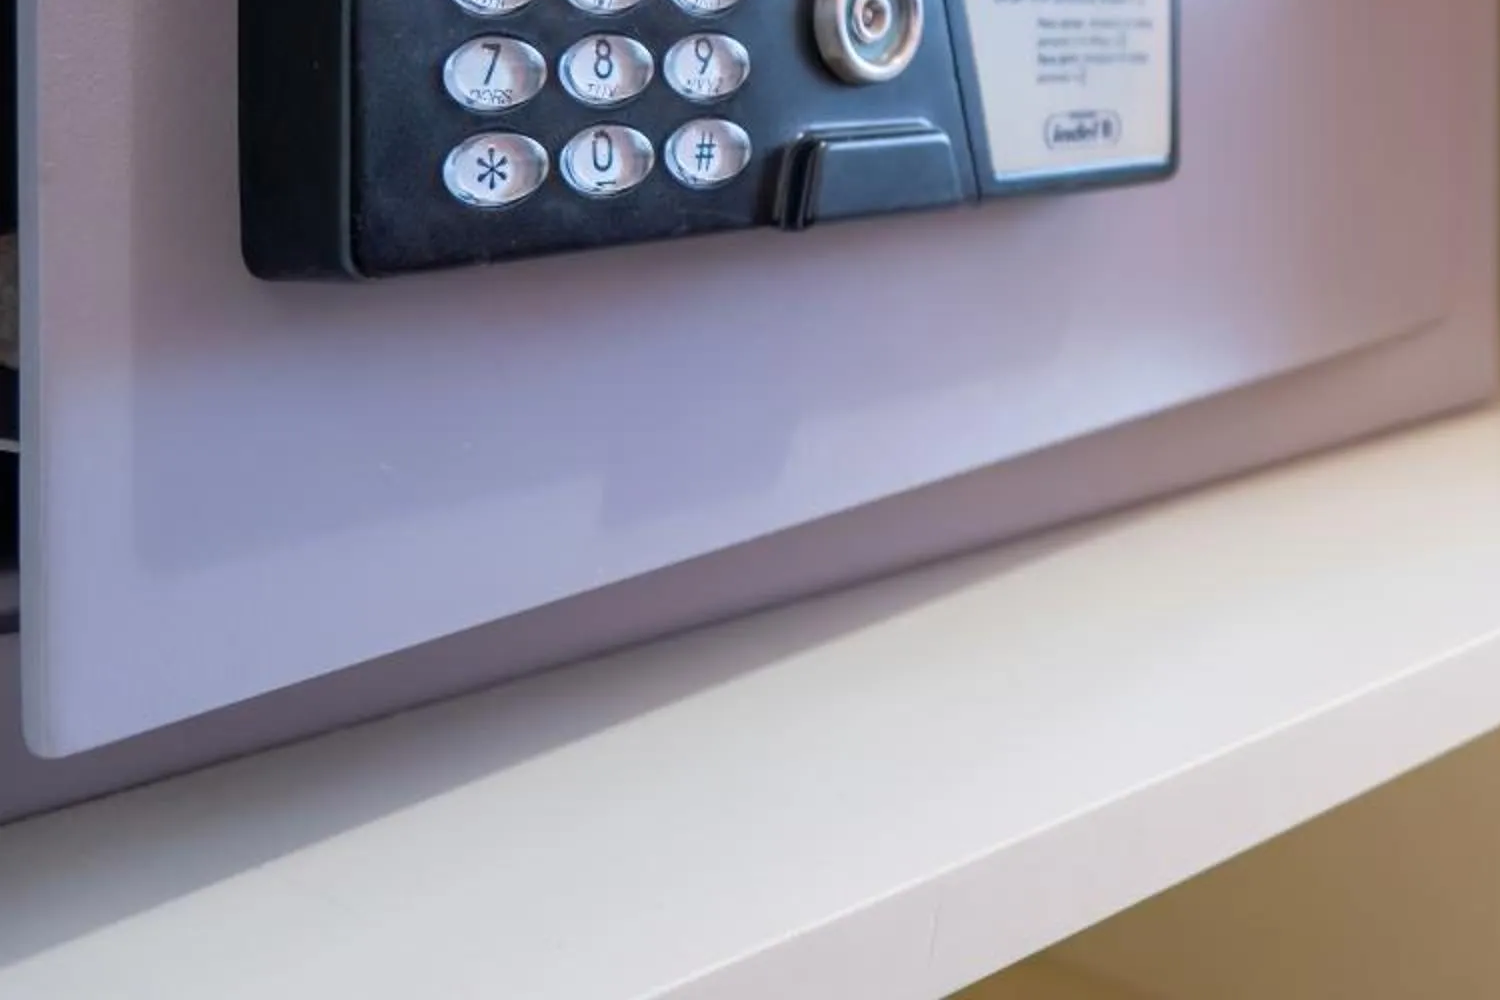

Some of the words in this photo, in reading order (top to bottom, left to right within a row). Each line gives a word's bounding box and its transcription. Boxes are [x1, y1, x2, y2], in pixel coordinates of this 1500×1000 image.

[482, 43, 502, 85] 7
[594, 38, 613, 79] 8
[695, 37, 713, 75] 9
[592, 130, 612, 172] 0
